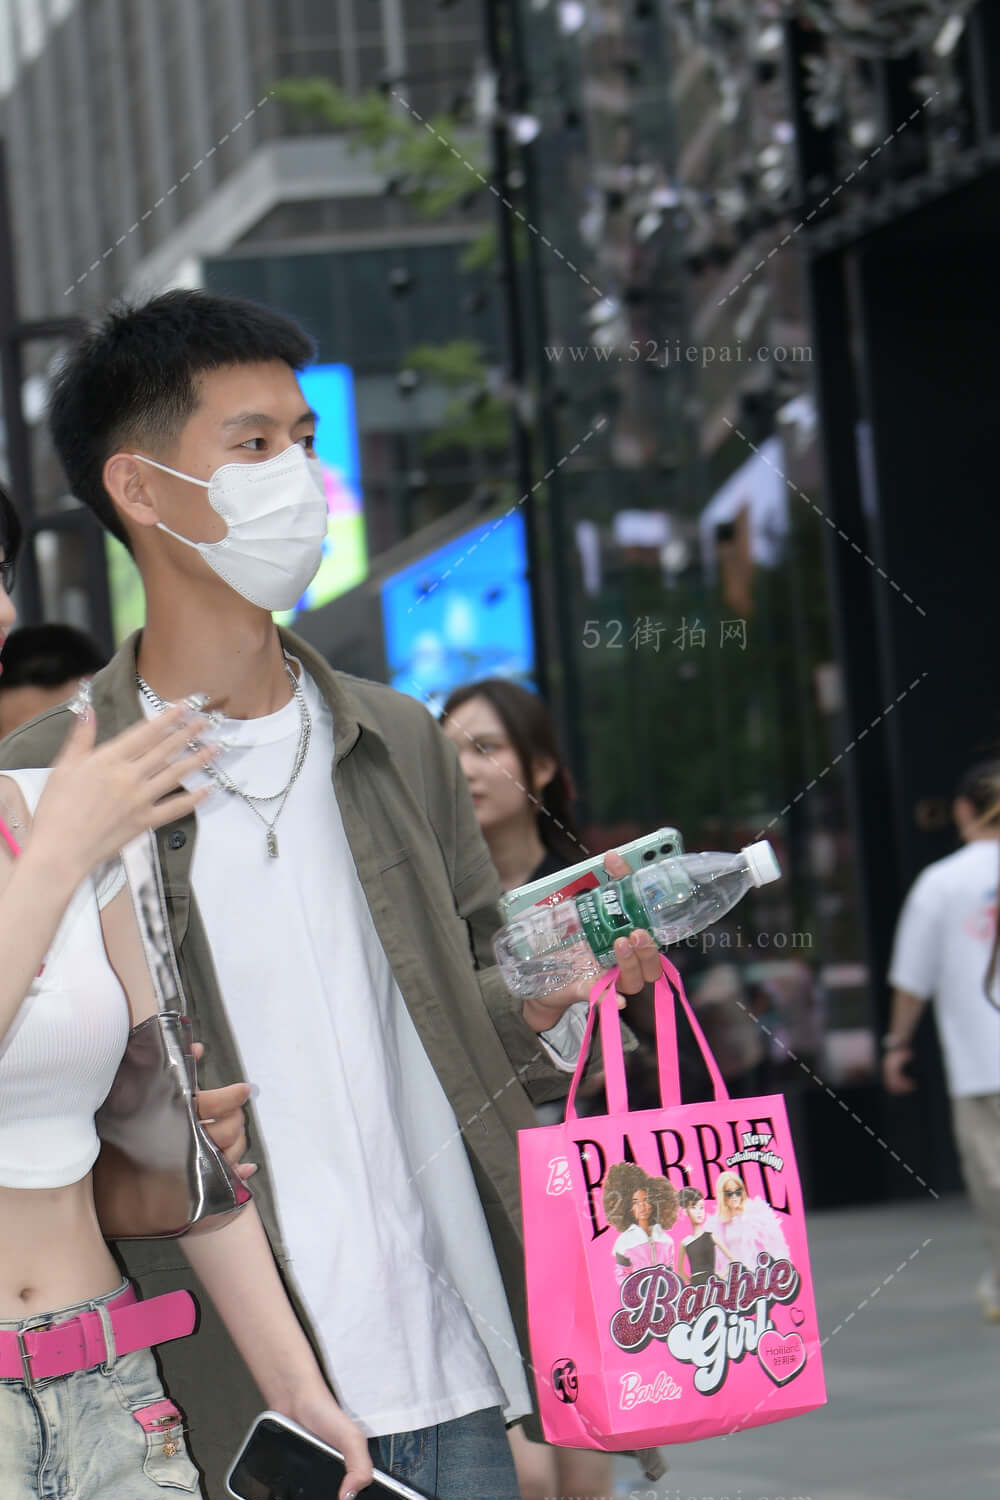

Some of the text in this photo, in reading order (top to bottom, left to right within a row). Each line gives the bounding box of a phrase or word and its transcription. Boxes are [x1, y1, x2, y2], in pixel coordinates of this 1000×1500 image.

[742, 1131, 774, 1149] New
[610, 1252, 799, 1352] Barbie
[667, 1298, 774, 1394] Girl
[619, 1370, 683, 1410] Barbie
